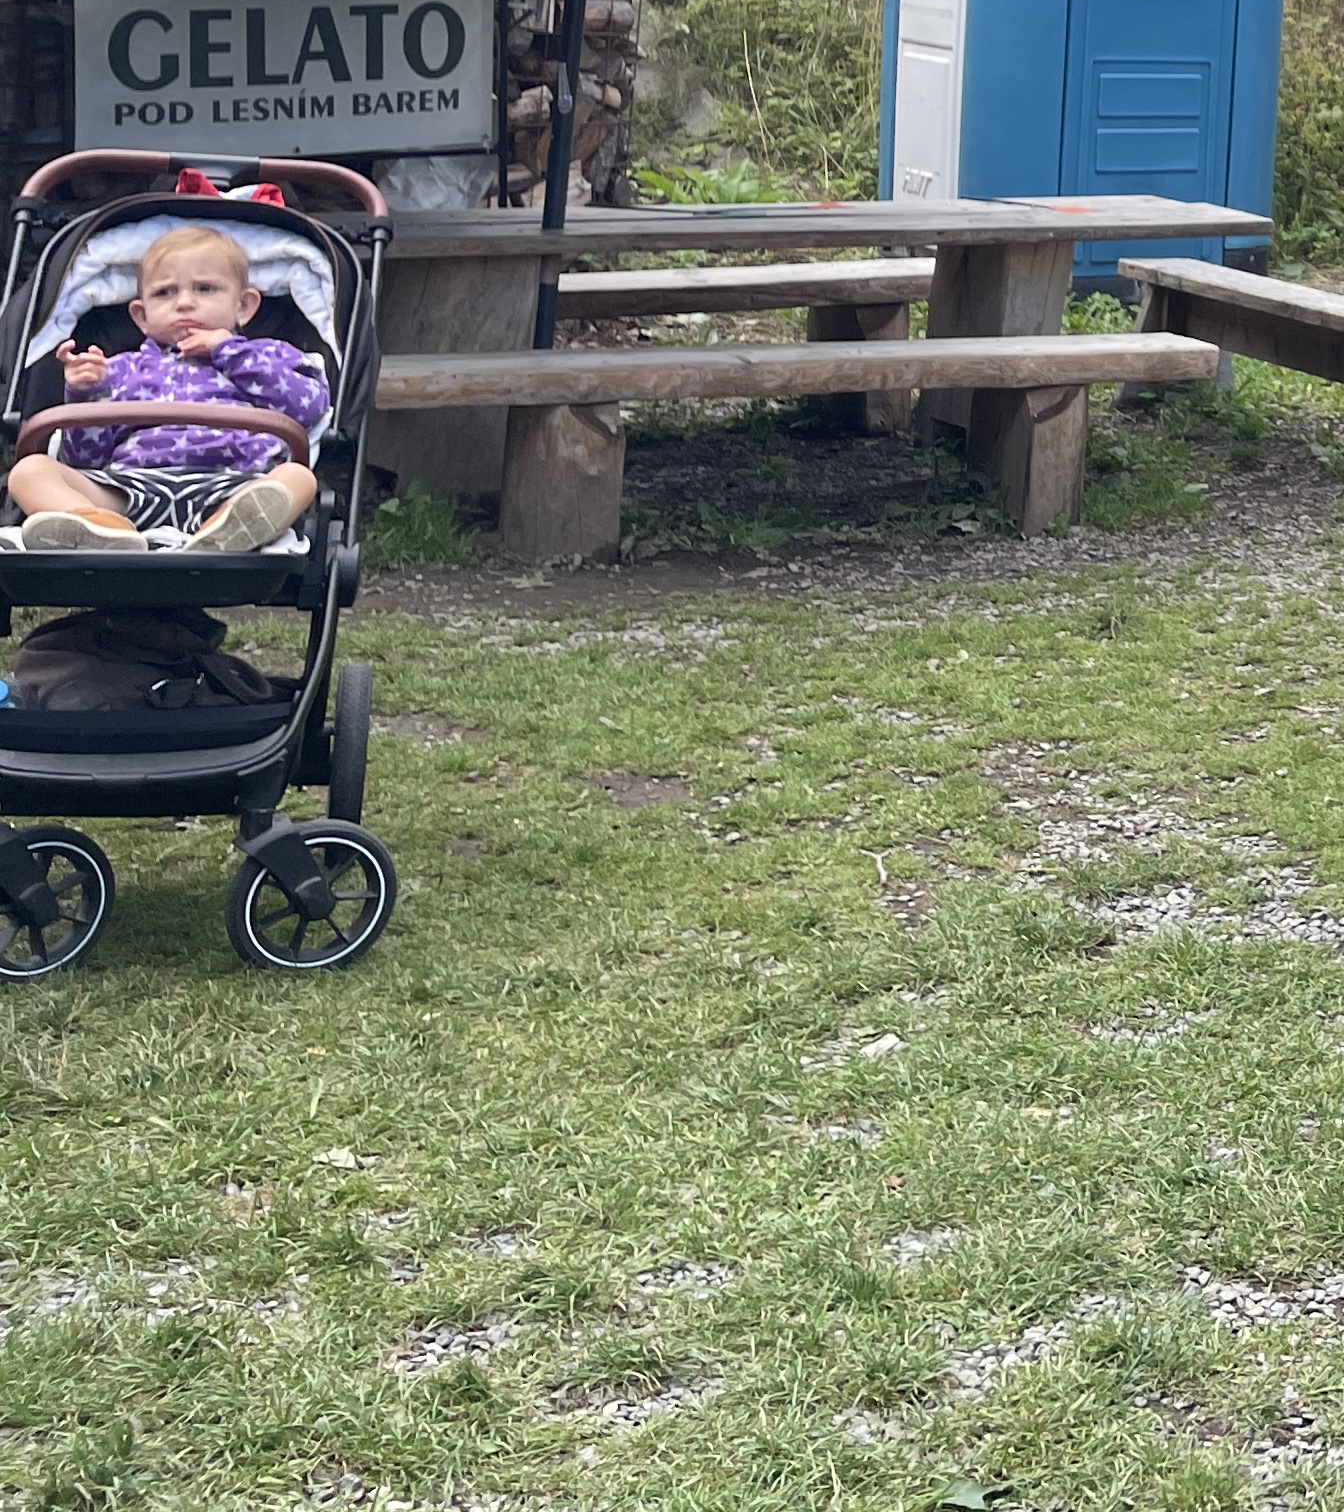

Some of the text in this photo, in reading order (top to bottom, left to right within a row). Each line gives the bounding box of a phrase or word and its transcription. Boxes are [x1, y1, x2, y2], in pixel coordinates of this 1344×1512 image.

[107, 2, 466, 91] GELATO
[113, 88, 461, 127] POD LESNÍM BAREM
